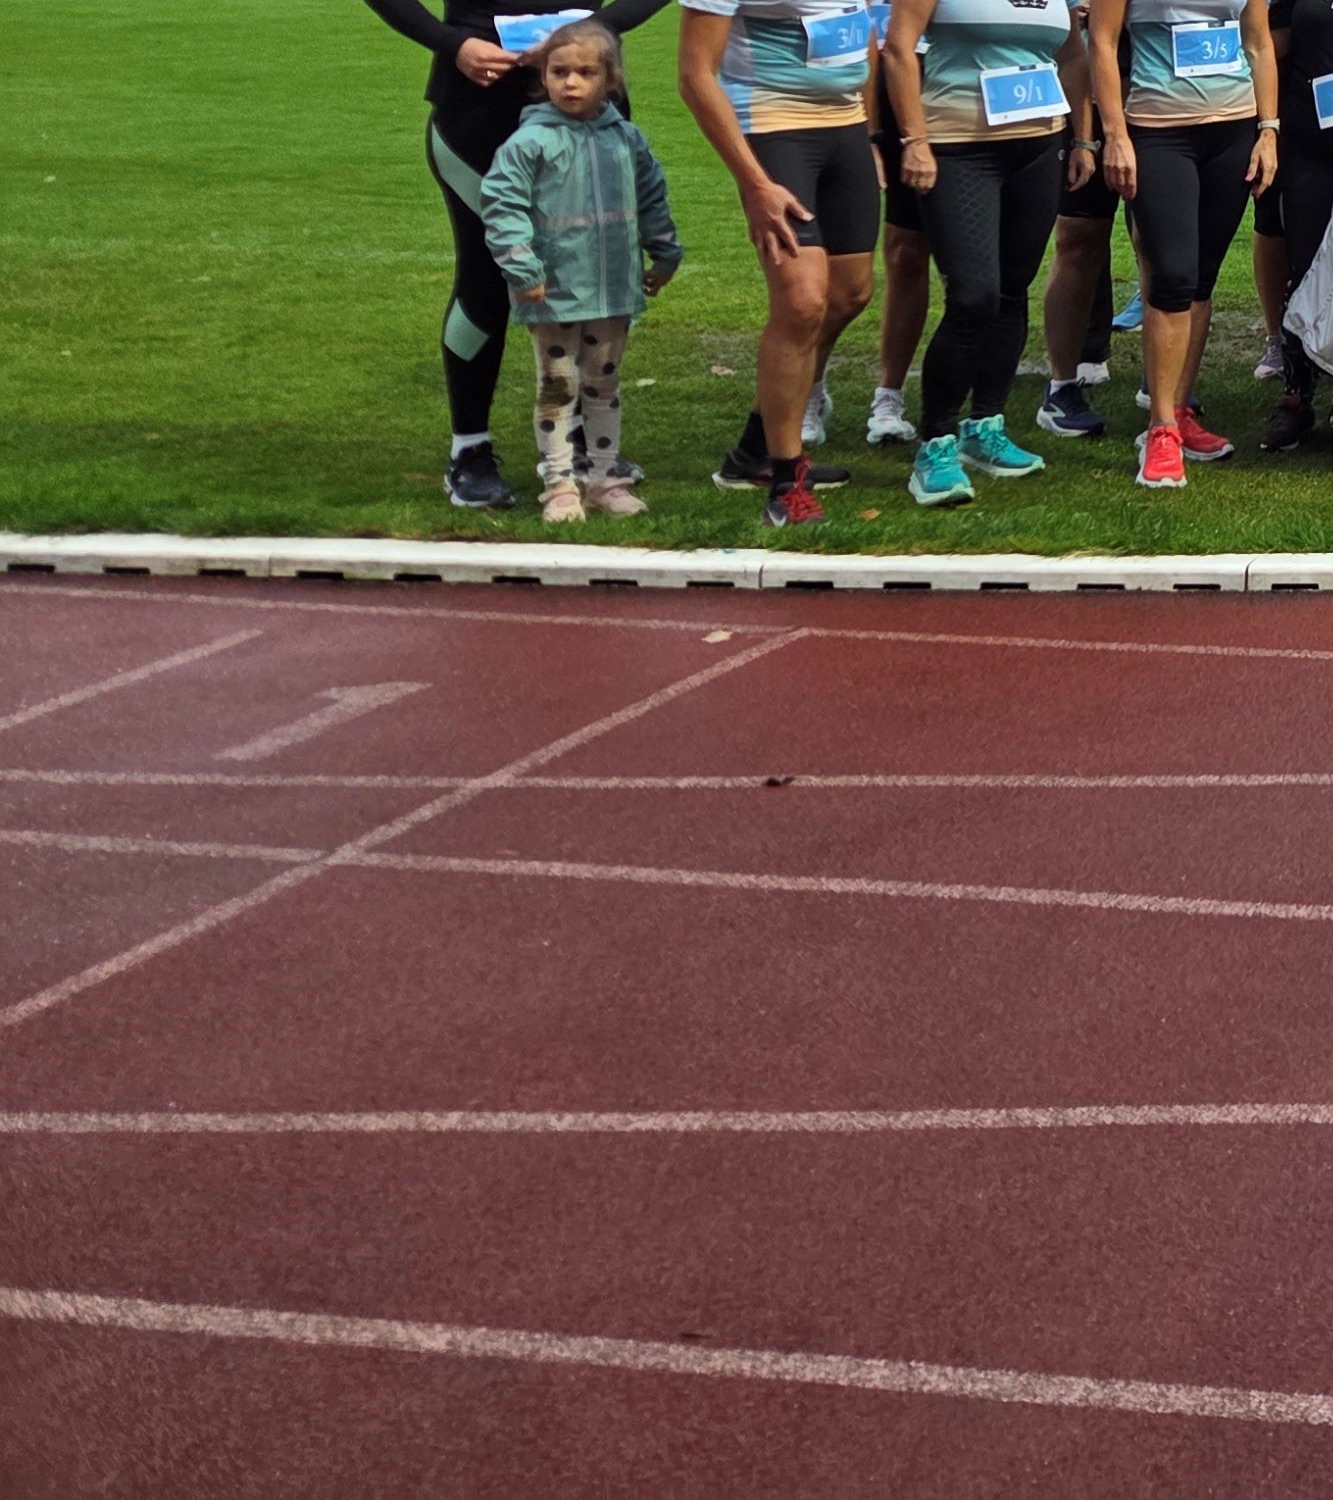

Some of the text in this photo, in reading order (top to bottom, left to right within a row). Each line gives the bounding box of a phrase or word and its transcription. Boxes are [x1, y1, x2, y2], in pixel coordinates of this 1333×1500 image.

[837, 20, 864, 49] 3/1
[1201, 36, 1229, 61] 3/5
[1012, 78, 1042, 106] 9/1
